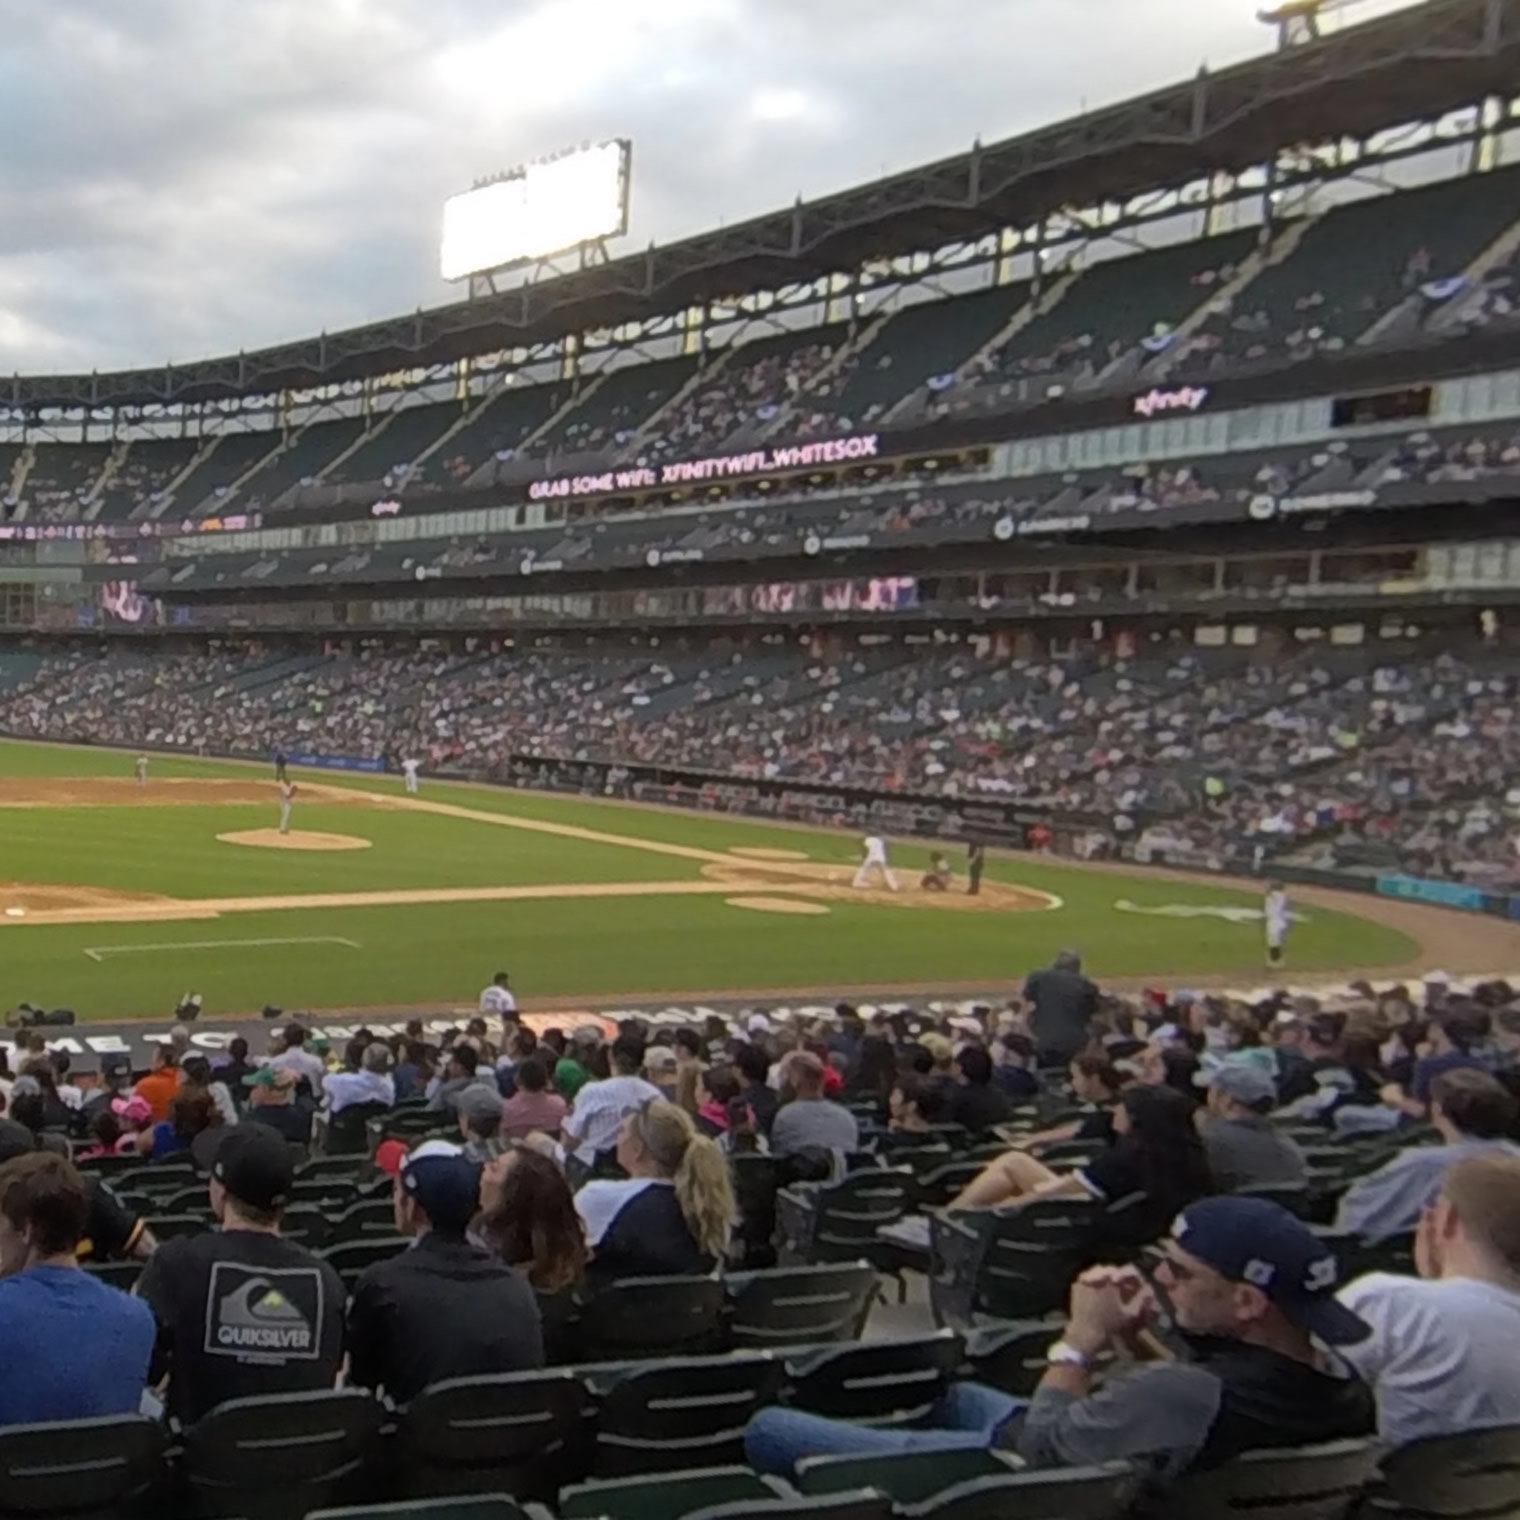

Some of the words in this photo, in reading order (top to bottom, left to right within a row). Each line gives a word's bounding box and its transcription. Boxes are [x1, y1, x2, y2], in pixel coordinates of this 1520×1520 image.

[529, 475, 569, 499] GRAB
[572, 472, 614, 495] SOME
[218, 1326, 310, 1348] QUIKSILVER
